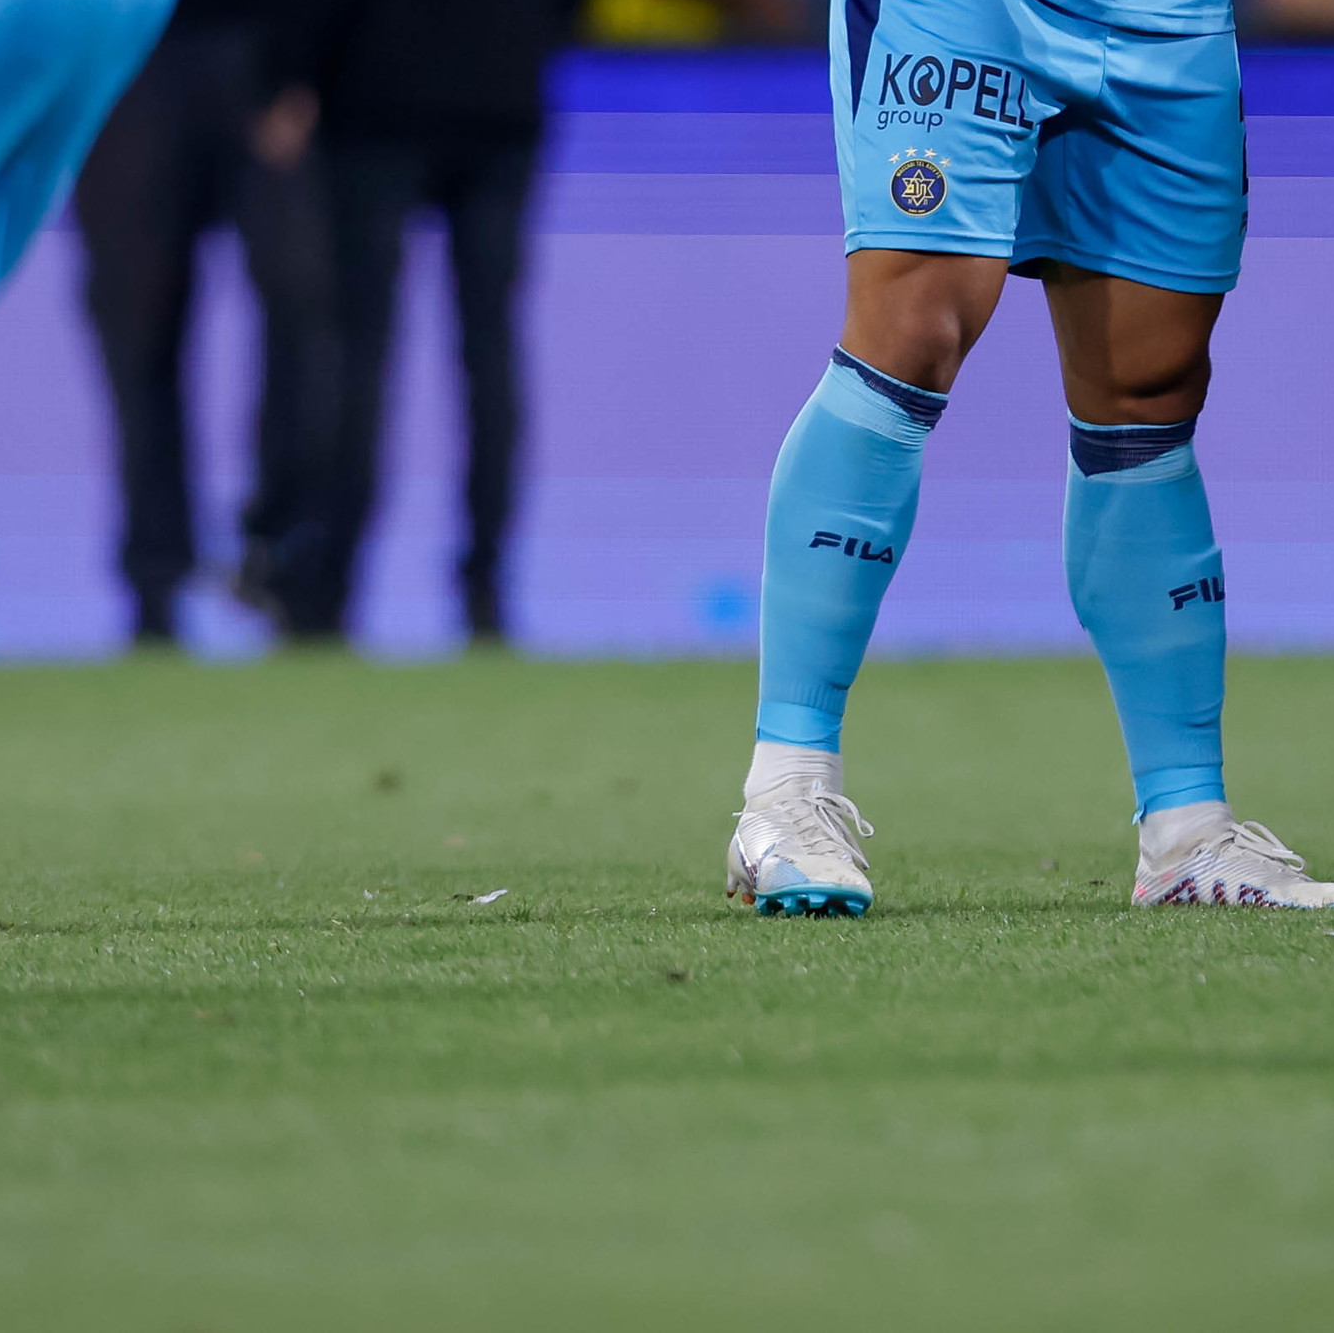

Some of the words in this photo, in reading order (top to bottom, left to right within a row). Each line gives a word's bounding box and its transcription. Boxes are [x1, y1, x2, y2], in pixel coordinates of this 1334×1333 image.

[878, 53, 1035, 130] KOPELL
[877, 110, 944, 133] group
[808, 530, 894, 565] FILA
